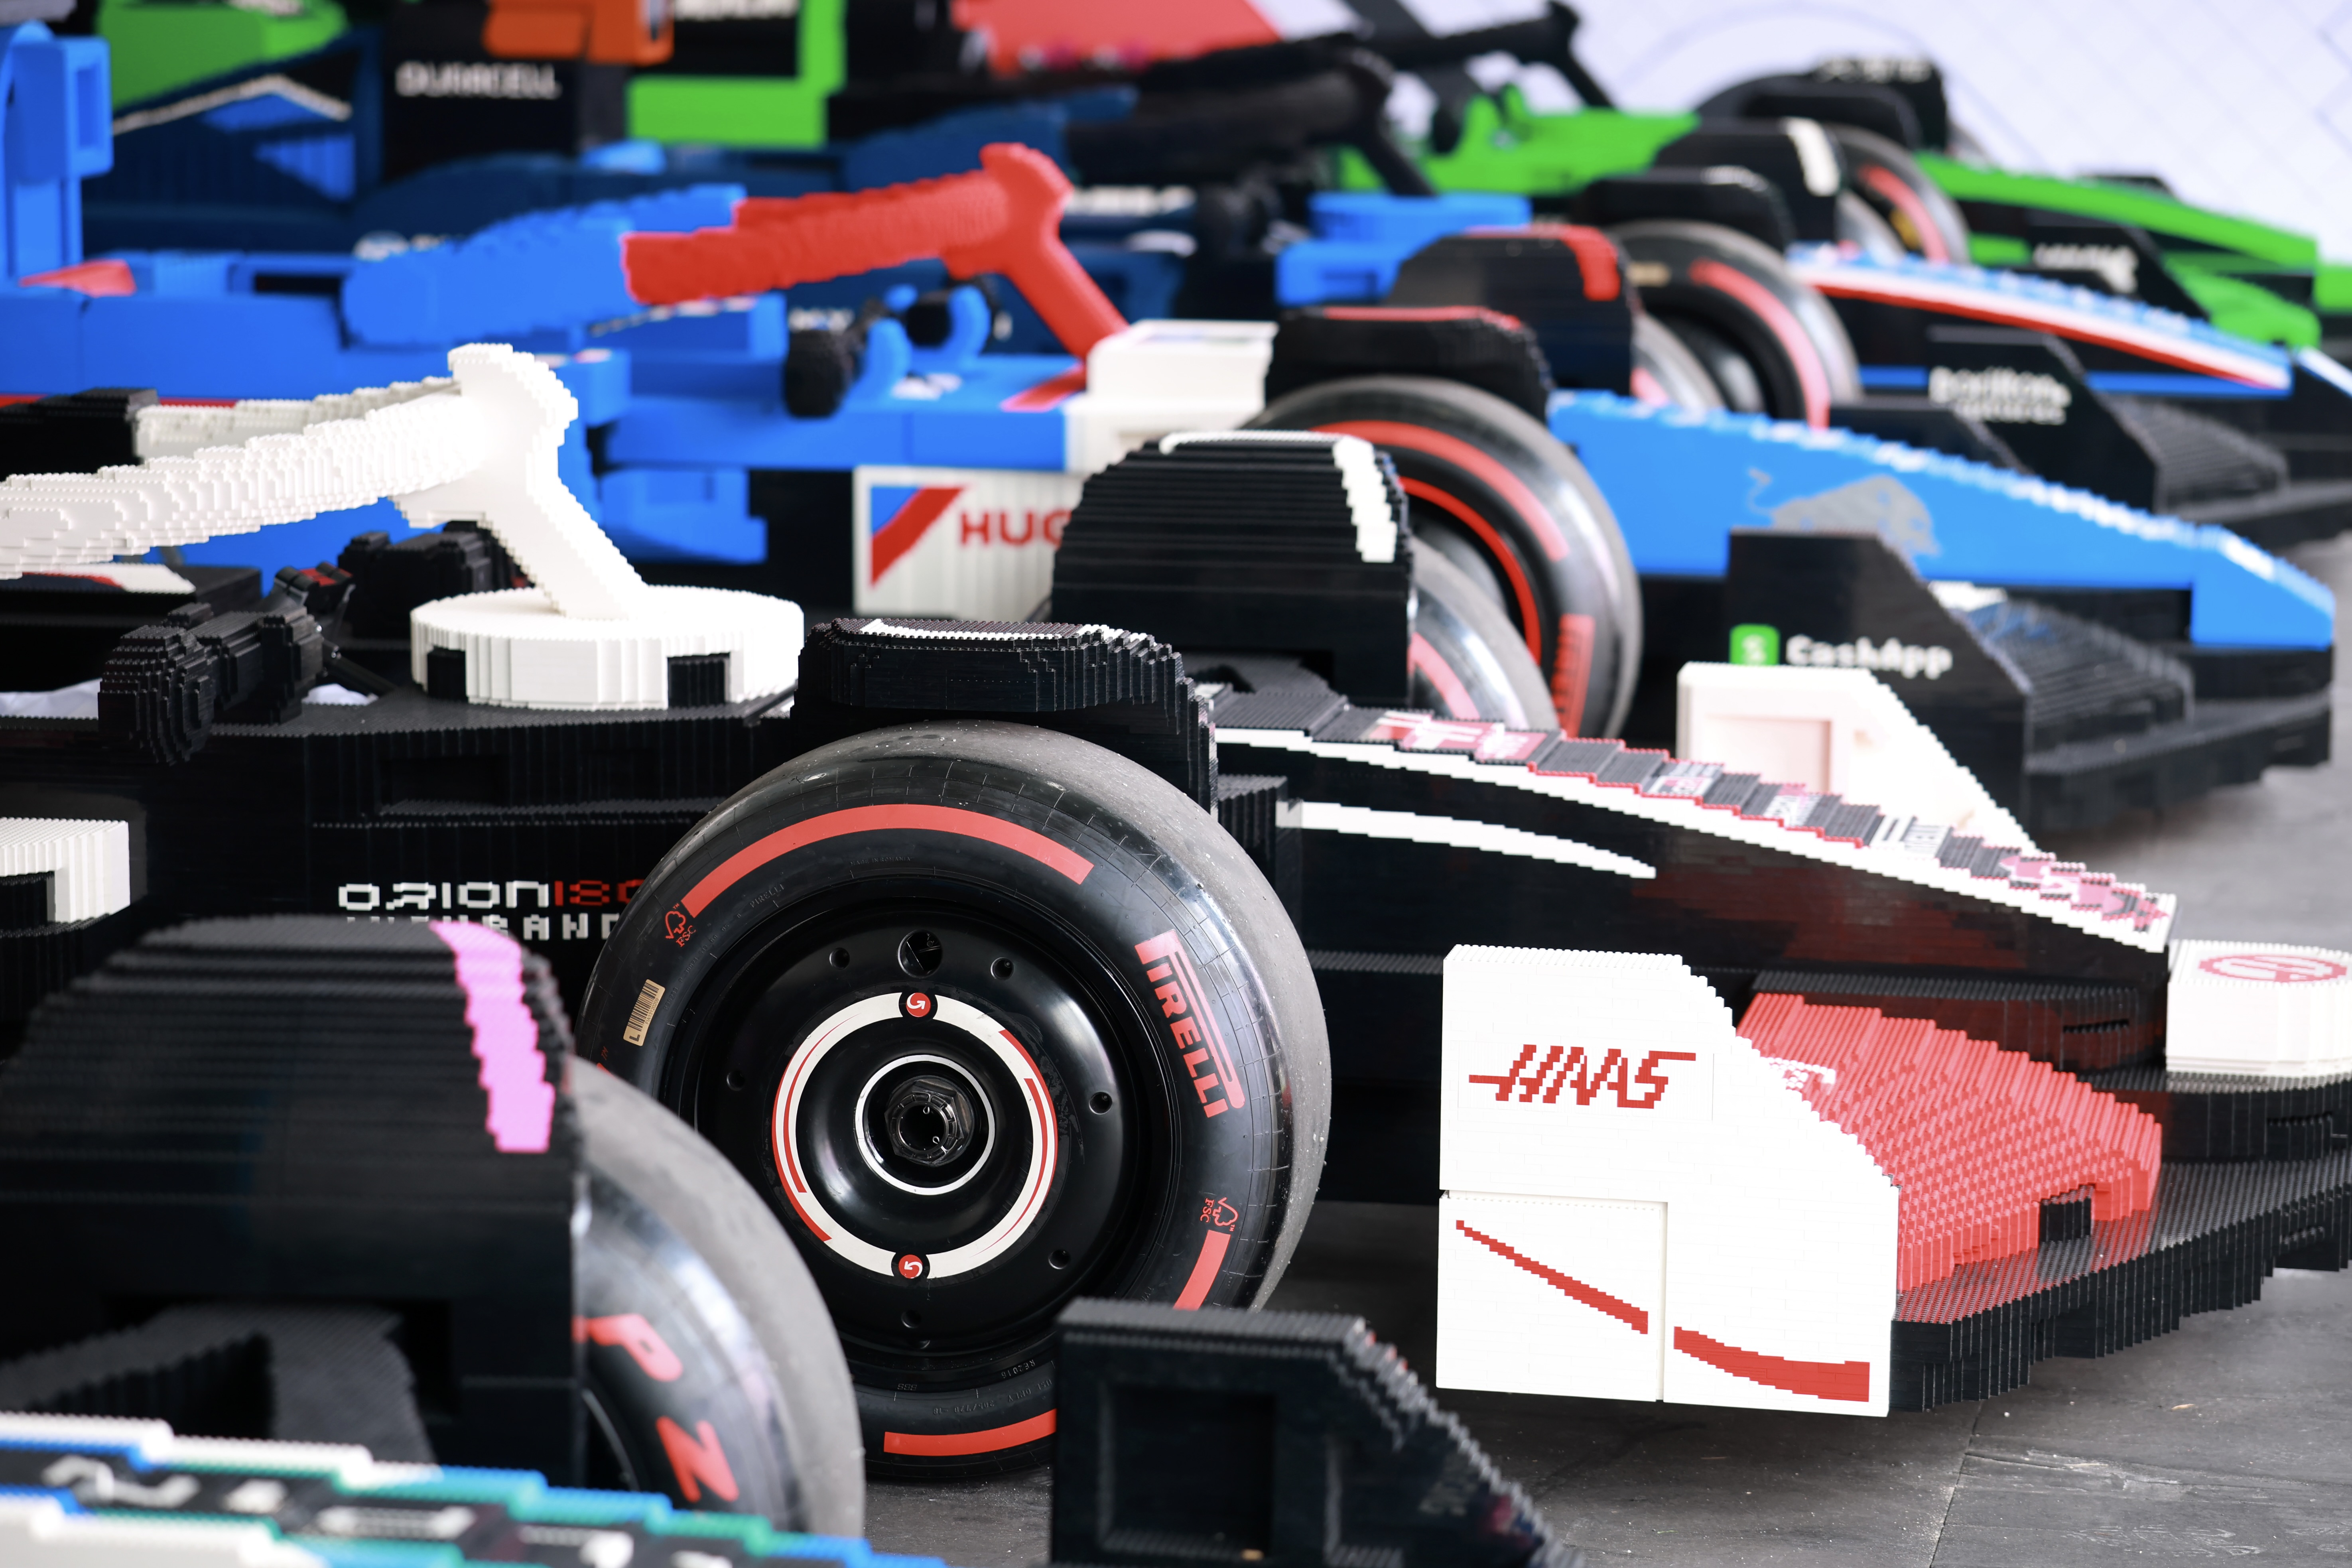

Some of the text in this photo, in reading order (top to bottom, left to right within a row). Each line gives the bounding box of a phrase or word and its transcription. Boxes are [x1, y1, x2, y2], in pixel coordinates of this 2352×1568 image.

[750, 884, 785, 908] PIRELLI
[675, 925, 696, 948] FSC
[645, 998, 660, 1025] FIA13120209
[1135, 929, 1245, 1118] PIRELLI
[1468, 1044, 1696, 1109] HAAS
[1200, 1198, 1215, 1223] FSC
